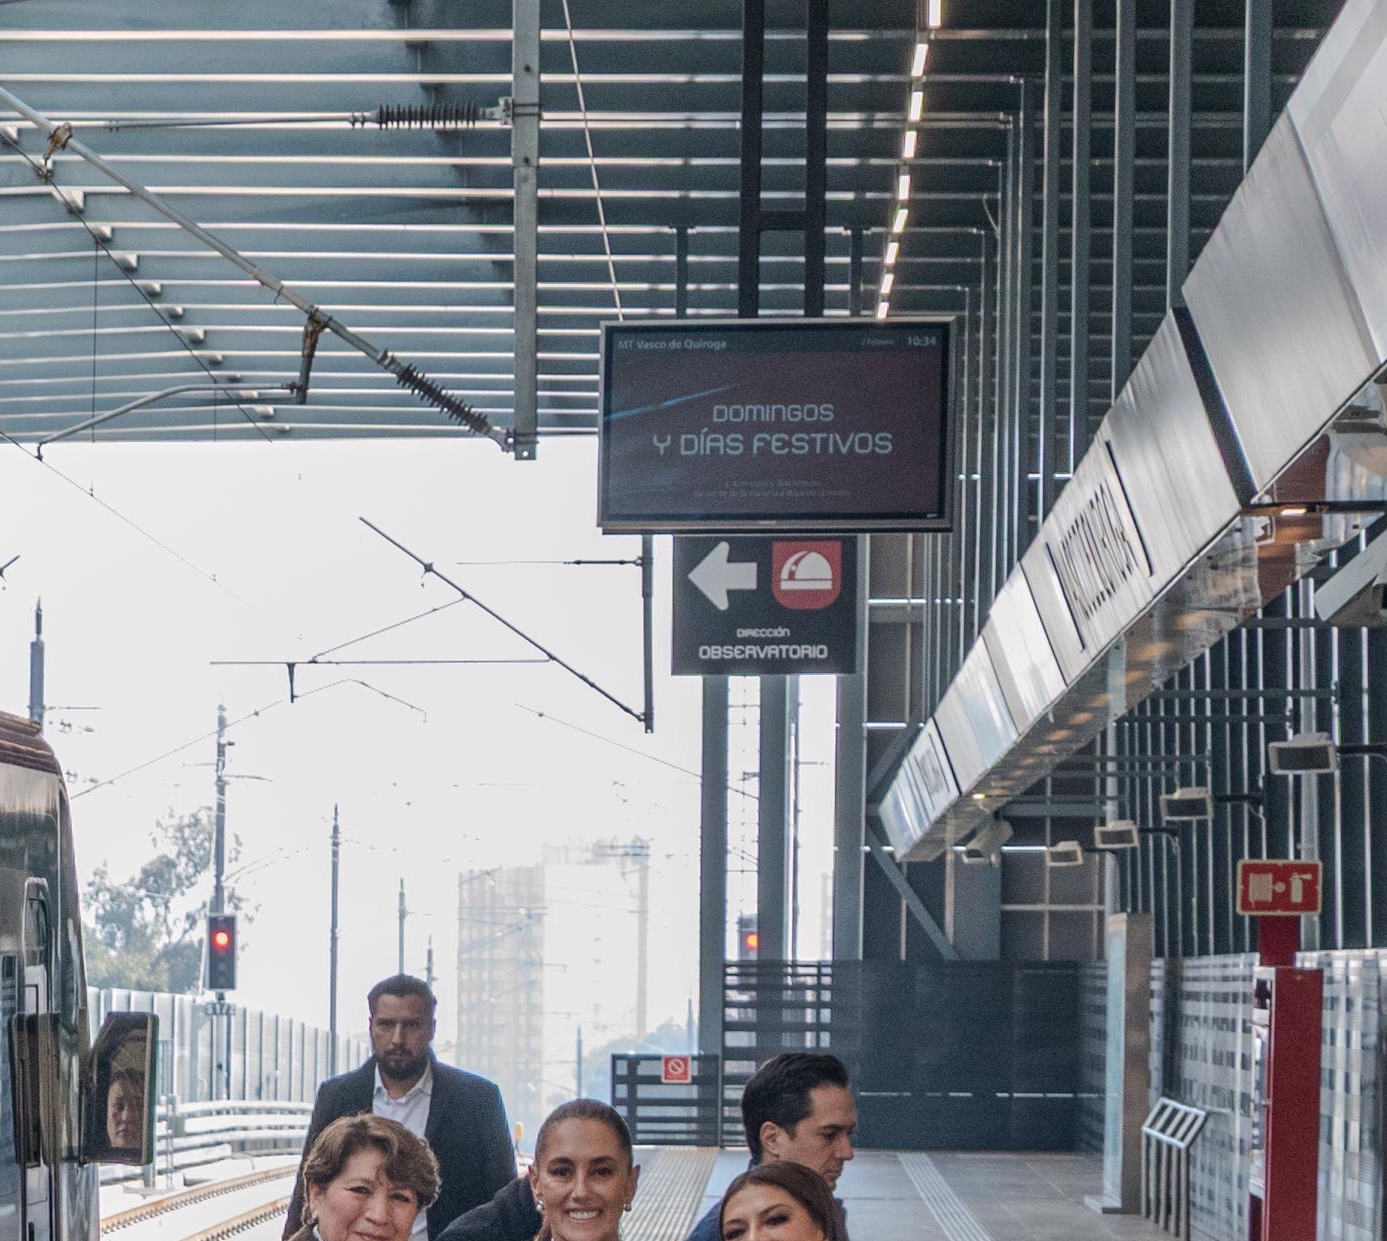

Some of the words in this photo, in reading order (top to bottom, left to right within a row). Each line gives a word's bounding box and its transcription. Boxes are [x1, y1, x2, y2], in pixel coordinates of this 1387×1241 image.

[669, 339, 683, 349] de
[684, 339, 727, 351] Quiroga
[713, 404, 834, 422] DOMINGOS
[653, 434, 671, 455] Y
[680, 427, 744, 455] DÍAS
[753, 432, 893, 454] FESTIVOS
[699, 644, 828, 659] OBSERVATORIO
